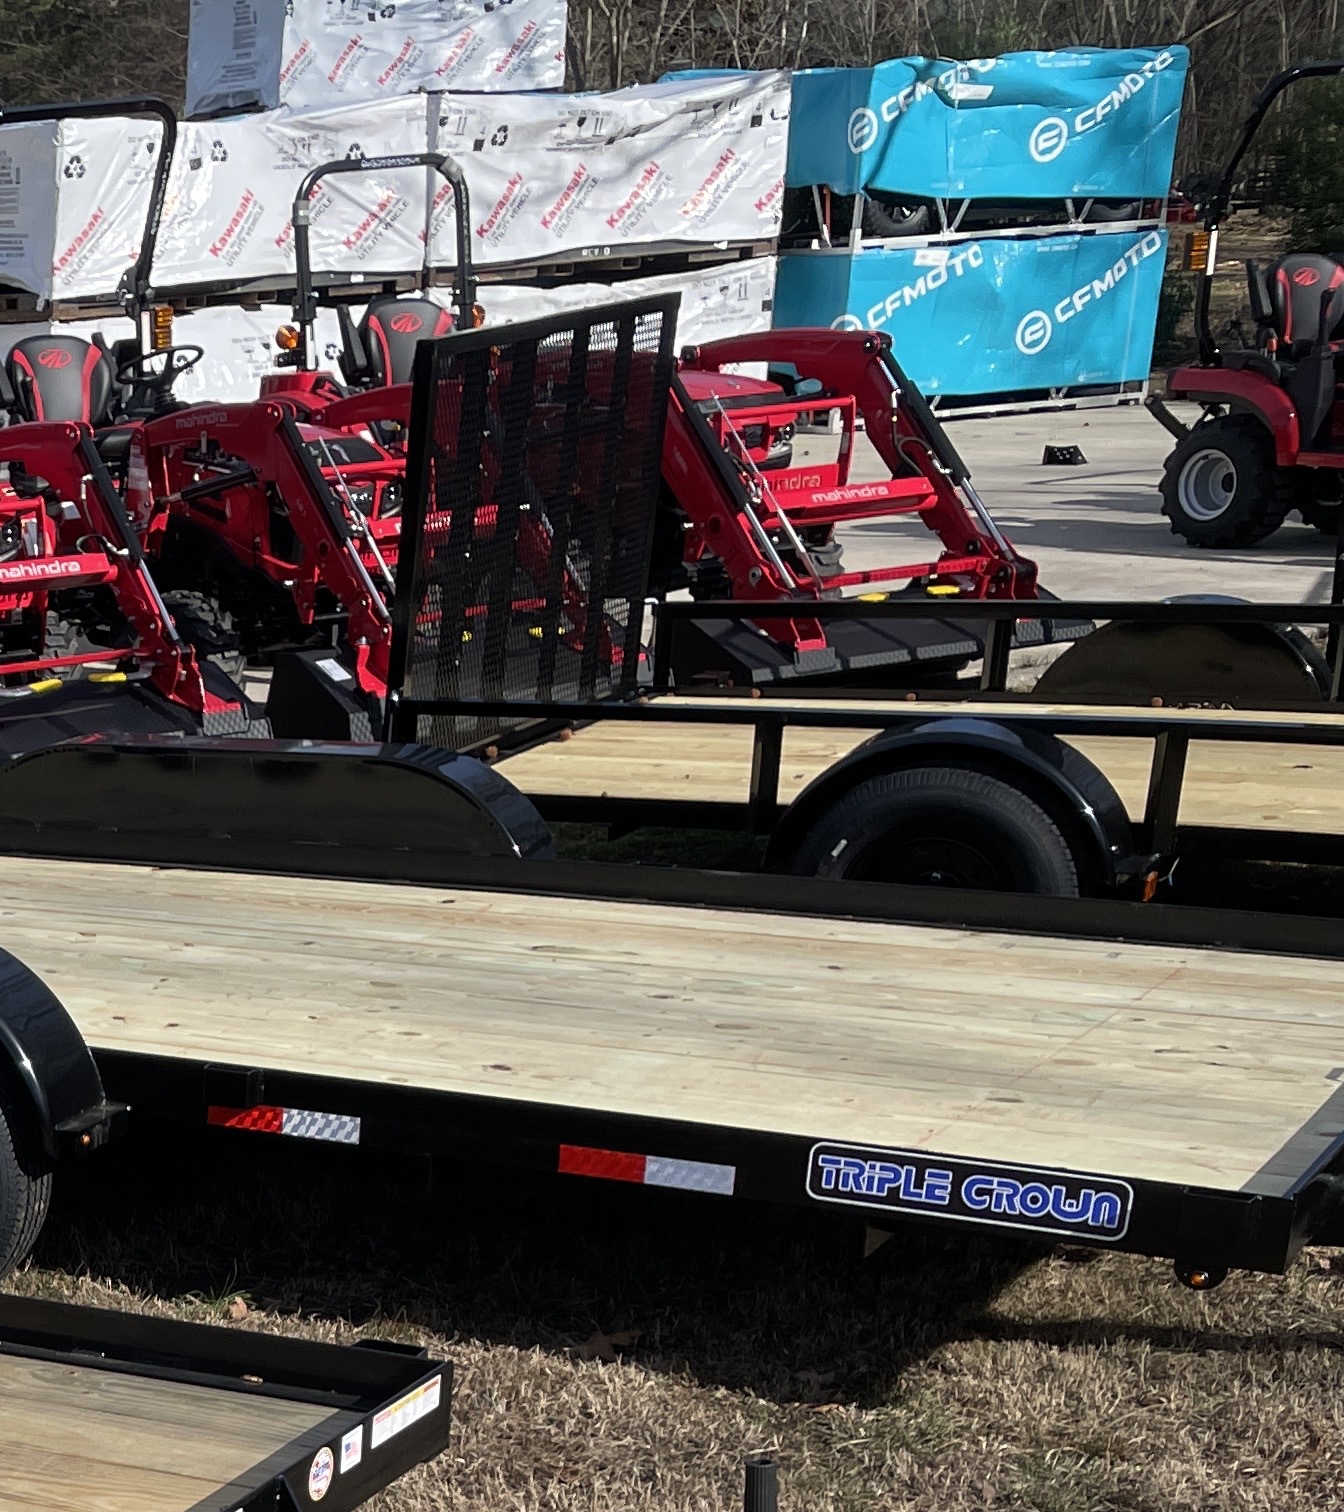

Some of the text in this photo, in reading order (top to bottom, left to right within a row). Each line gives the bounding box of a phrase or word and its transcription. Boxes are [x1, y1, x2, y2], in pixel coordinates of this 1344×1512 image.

[209, 188, 255, 258] Kawasaki
[476, 171, 523, 239] Kawasaki
[540, 162, 588, 230] Kawasaki
[605, 160, 660, 230] Kawasaki
[866, 244, 984, 331] CFMOTO
[1054, 230, 1162, 324] CFMOTO
[812, 485, 889, 503] mahindra
[818, 1154, 1121, 1229] TRIPLE CROWN
